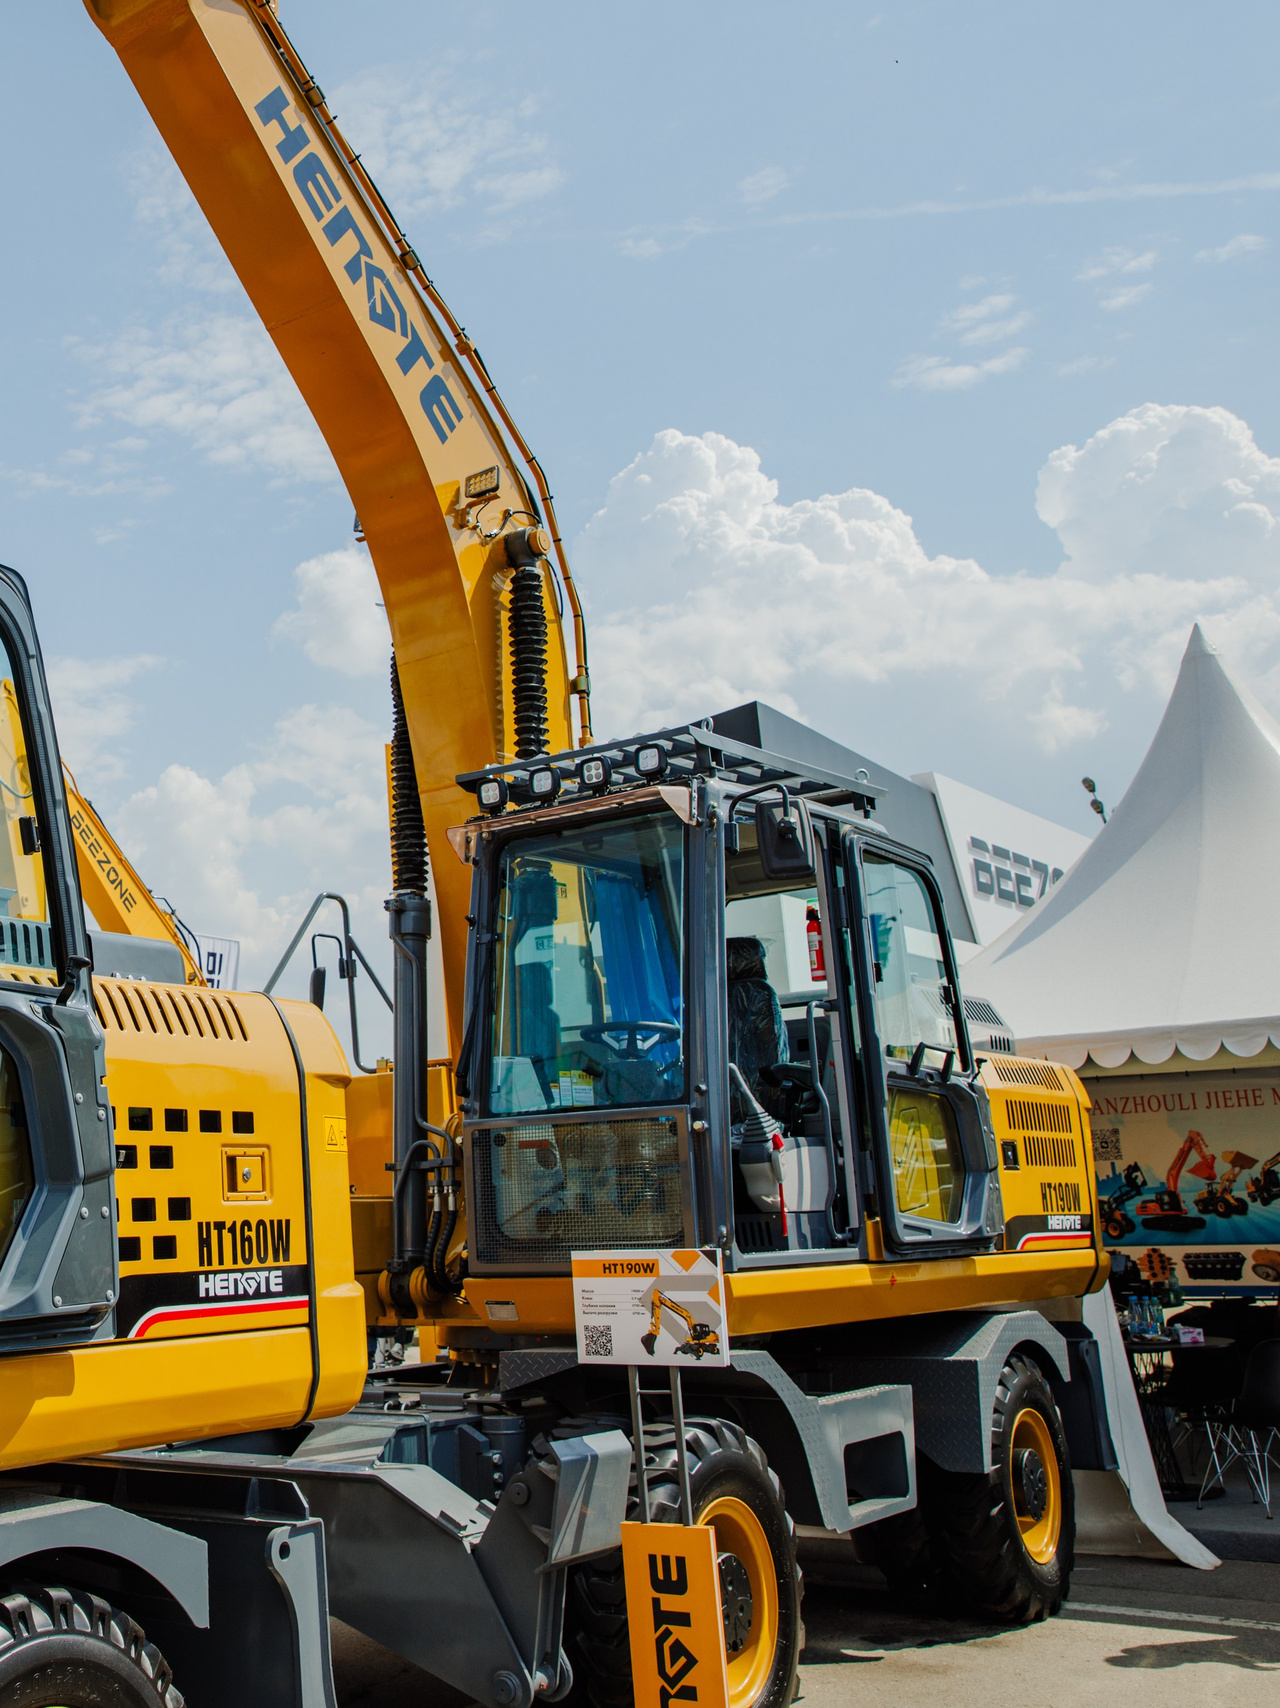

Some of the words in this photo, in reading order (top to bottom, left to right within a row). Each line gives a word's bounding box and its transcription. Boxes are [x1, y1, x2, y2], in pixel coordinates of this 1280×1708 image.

[70, 810, 137, 913] BEEZONE
[1092, 1092, 1197, 1116] ANZHOULI
[1206, 1088, 1265, 1110] JIEHE
[1040, 1182, 1081, 1213] HT190W
[197, 1219, 291, 1267] HT160W
[602, 1263, 655, 1275] HT190W
